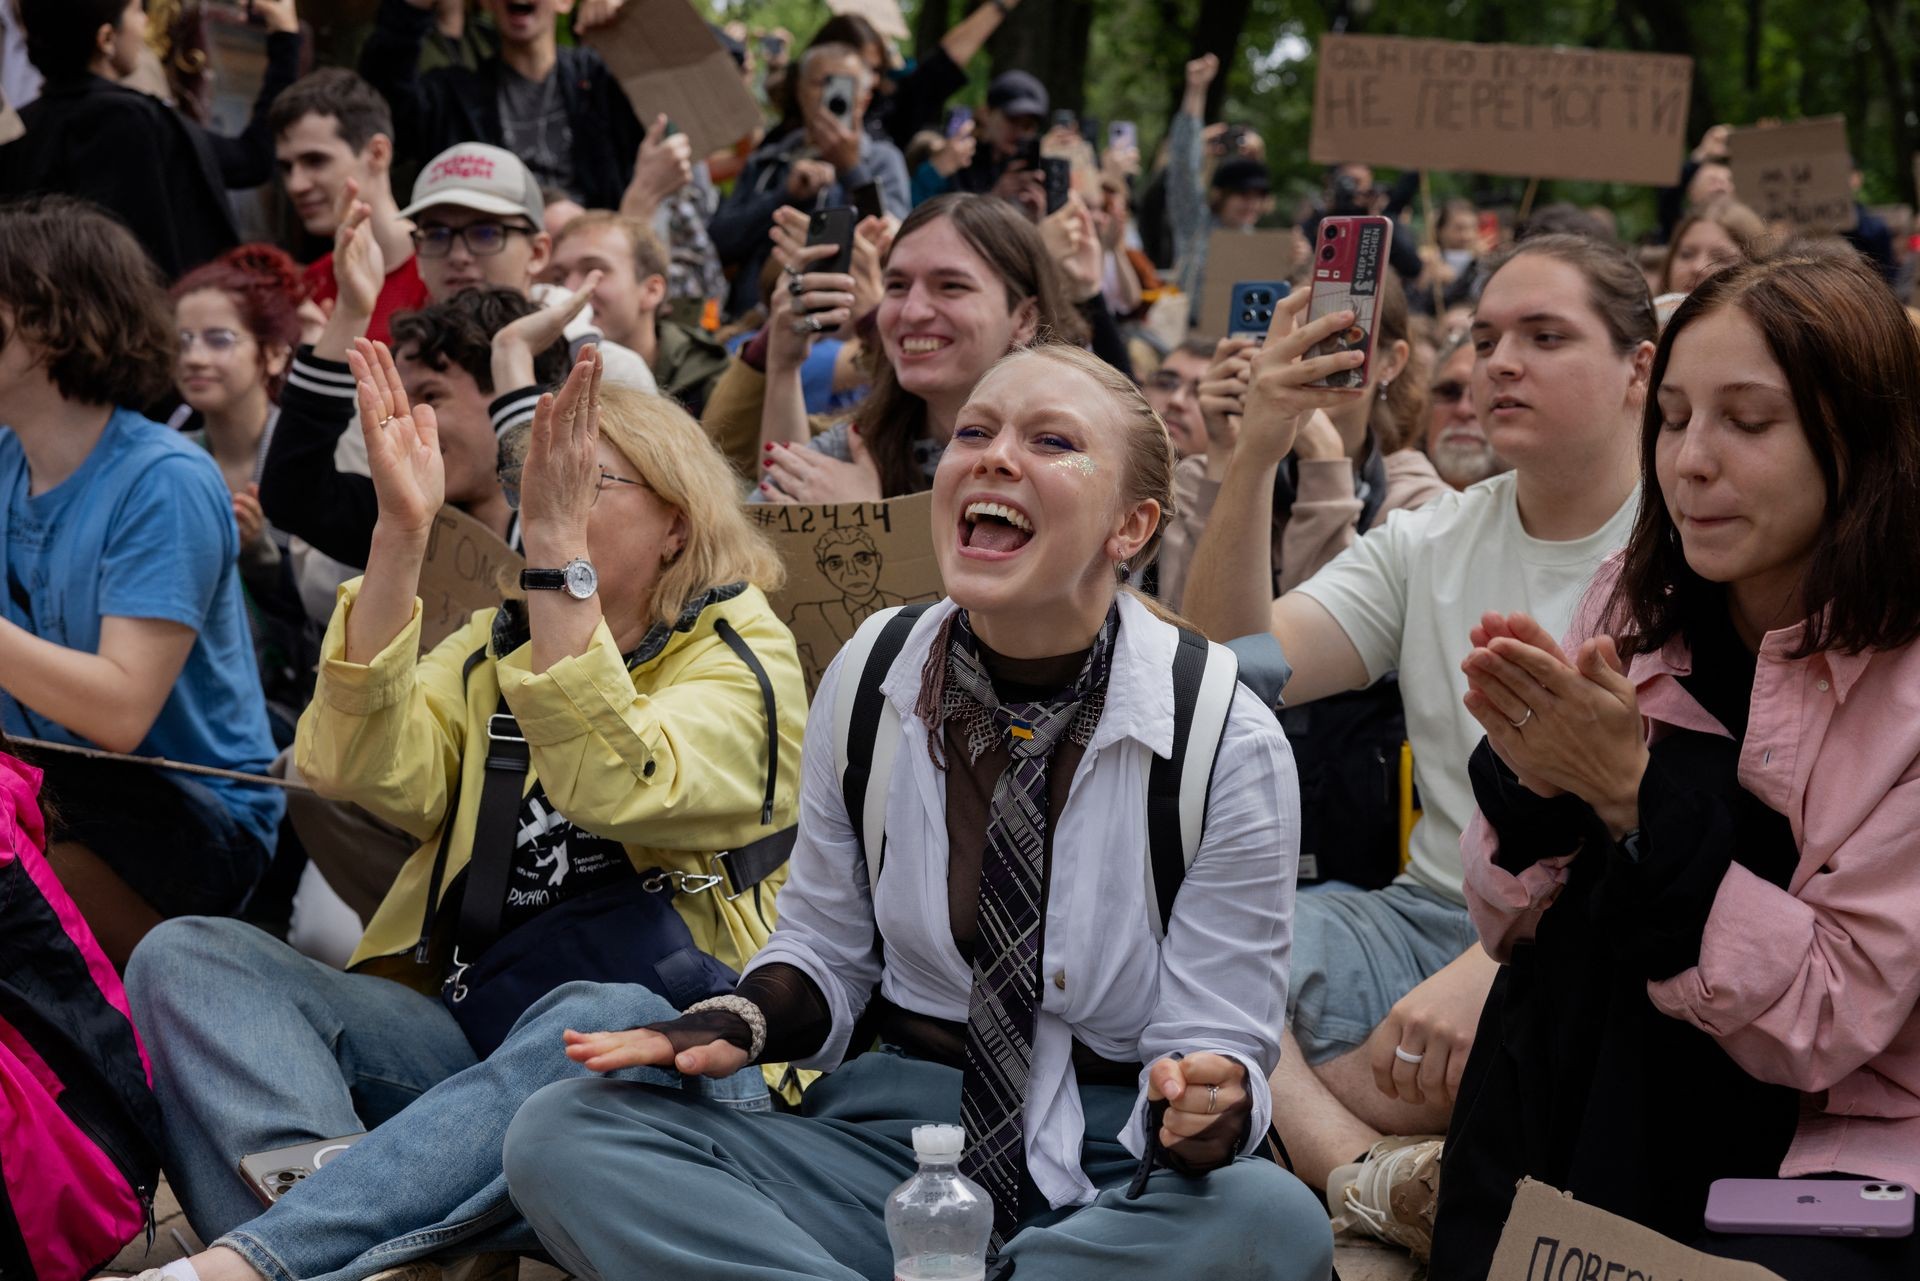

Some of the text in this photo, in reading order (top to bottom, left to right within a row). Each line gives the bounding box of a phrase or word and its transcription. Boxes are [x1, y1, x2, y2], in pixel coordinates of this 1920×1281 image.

[1323, 76, 1682, 136] НЕ ПЕРЕМОГТИ
[1356, 227, 1372, 279] DEEP STATE
[1367, 228, 1381, 267] LACHEN
[753, 503, 891, 533] #12414
